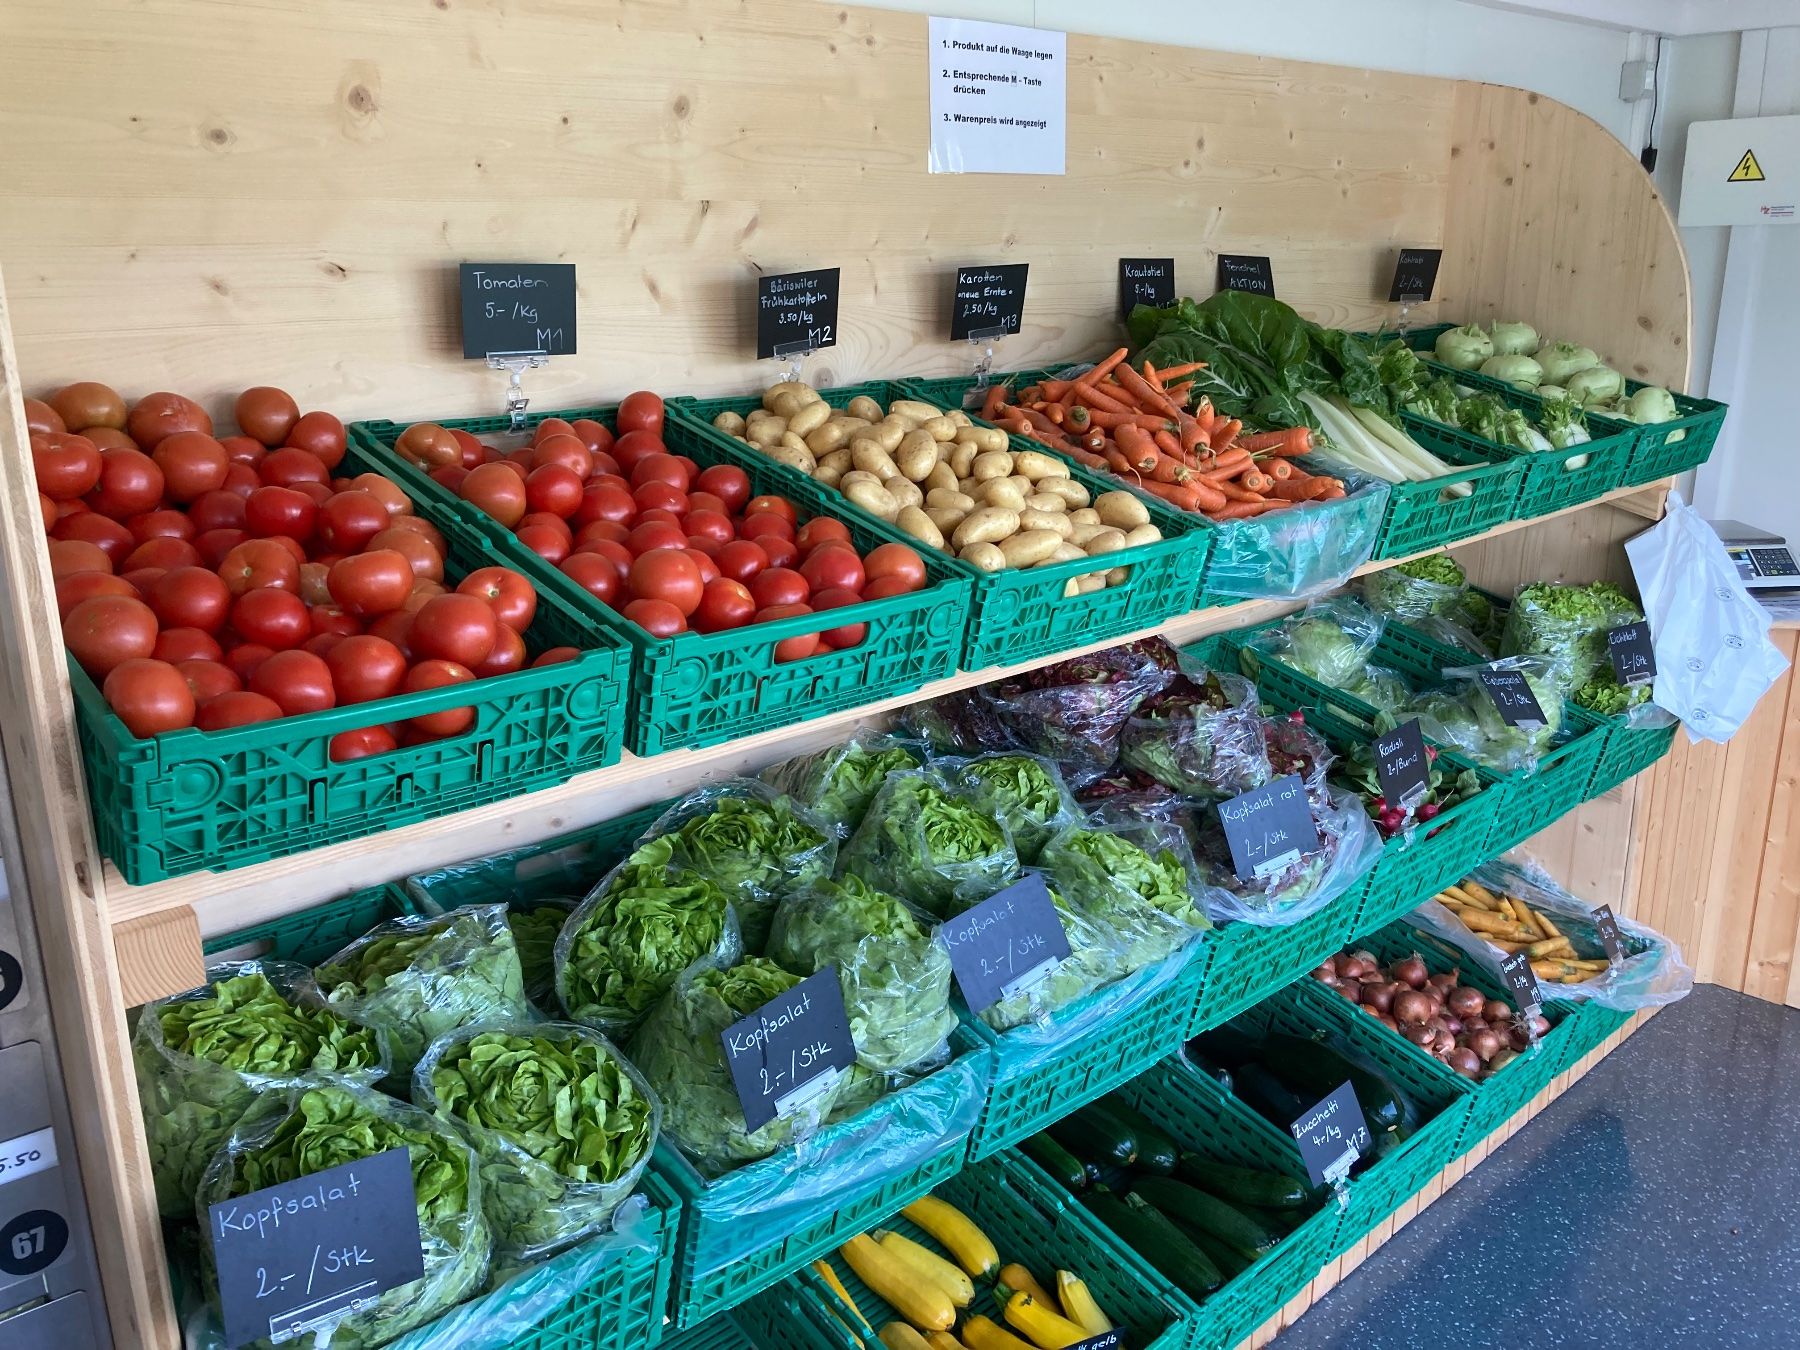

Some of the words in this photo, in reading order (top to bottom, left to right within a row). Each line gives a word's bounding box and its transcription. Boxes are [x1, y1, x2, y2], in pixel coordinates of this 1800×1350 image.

[942, 40, 950, 48] 1.
[952, 40, 984, 51] Produkt
[986, 44, 998, 52] auf
[999, 45, 1010, 54] die
[1011, 46, 1033, 58] Waage
[1034, 50, 1053, 60] legen
[942, 69, 951, 78] 2.
[953, 70, 1010, 83] Entsprechende
[1011, 75, 1018, 83] M
[1023, 76, 1042, 87] Taste
[953, 84, 986, 95] drücken
[943, 113, 952, 122] 3.
[953, 113, 998, 124] Warenpreis
[999, 117, 1014, 126] wird
[1015, 119, 1047, 130] angezeigt
[1124, 264, 1165, 279] Krautstiel
[1224, 259, 1261, 276] Fenchel
[472, 271, 549, 289] Tomaten
[960, 270, 1003, 284] Karotten
[1230, 277, 1266, 291] AKTION
[760, 292, 828, 309] Frühkartoffeln
[962, 301, 998, 318] 2.50/kg
[778, 310, 813, 327] 3.50/kg
[1001, 313, 1017, 329] M3
[536, 327, 563, 350] M1
[808, 325, 833, 347] M2
[1221, 792, 1274, 824] Kopfsalat
[1280, 784, 1298, 800] rot
[942, 901, 1015, 950] Kopfsalat
[729, 992, 811, 1059] Kopfsalat
[1292, 1099, 1339, 1139] Zucchetti
[218, 1172, 361, 1239] Kopfsalat
[11, 1225, 46, 1260] 67
